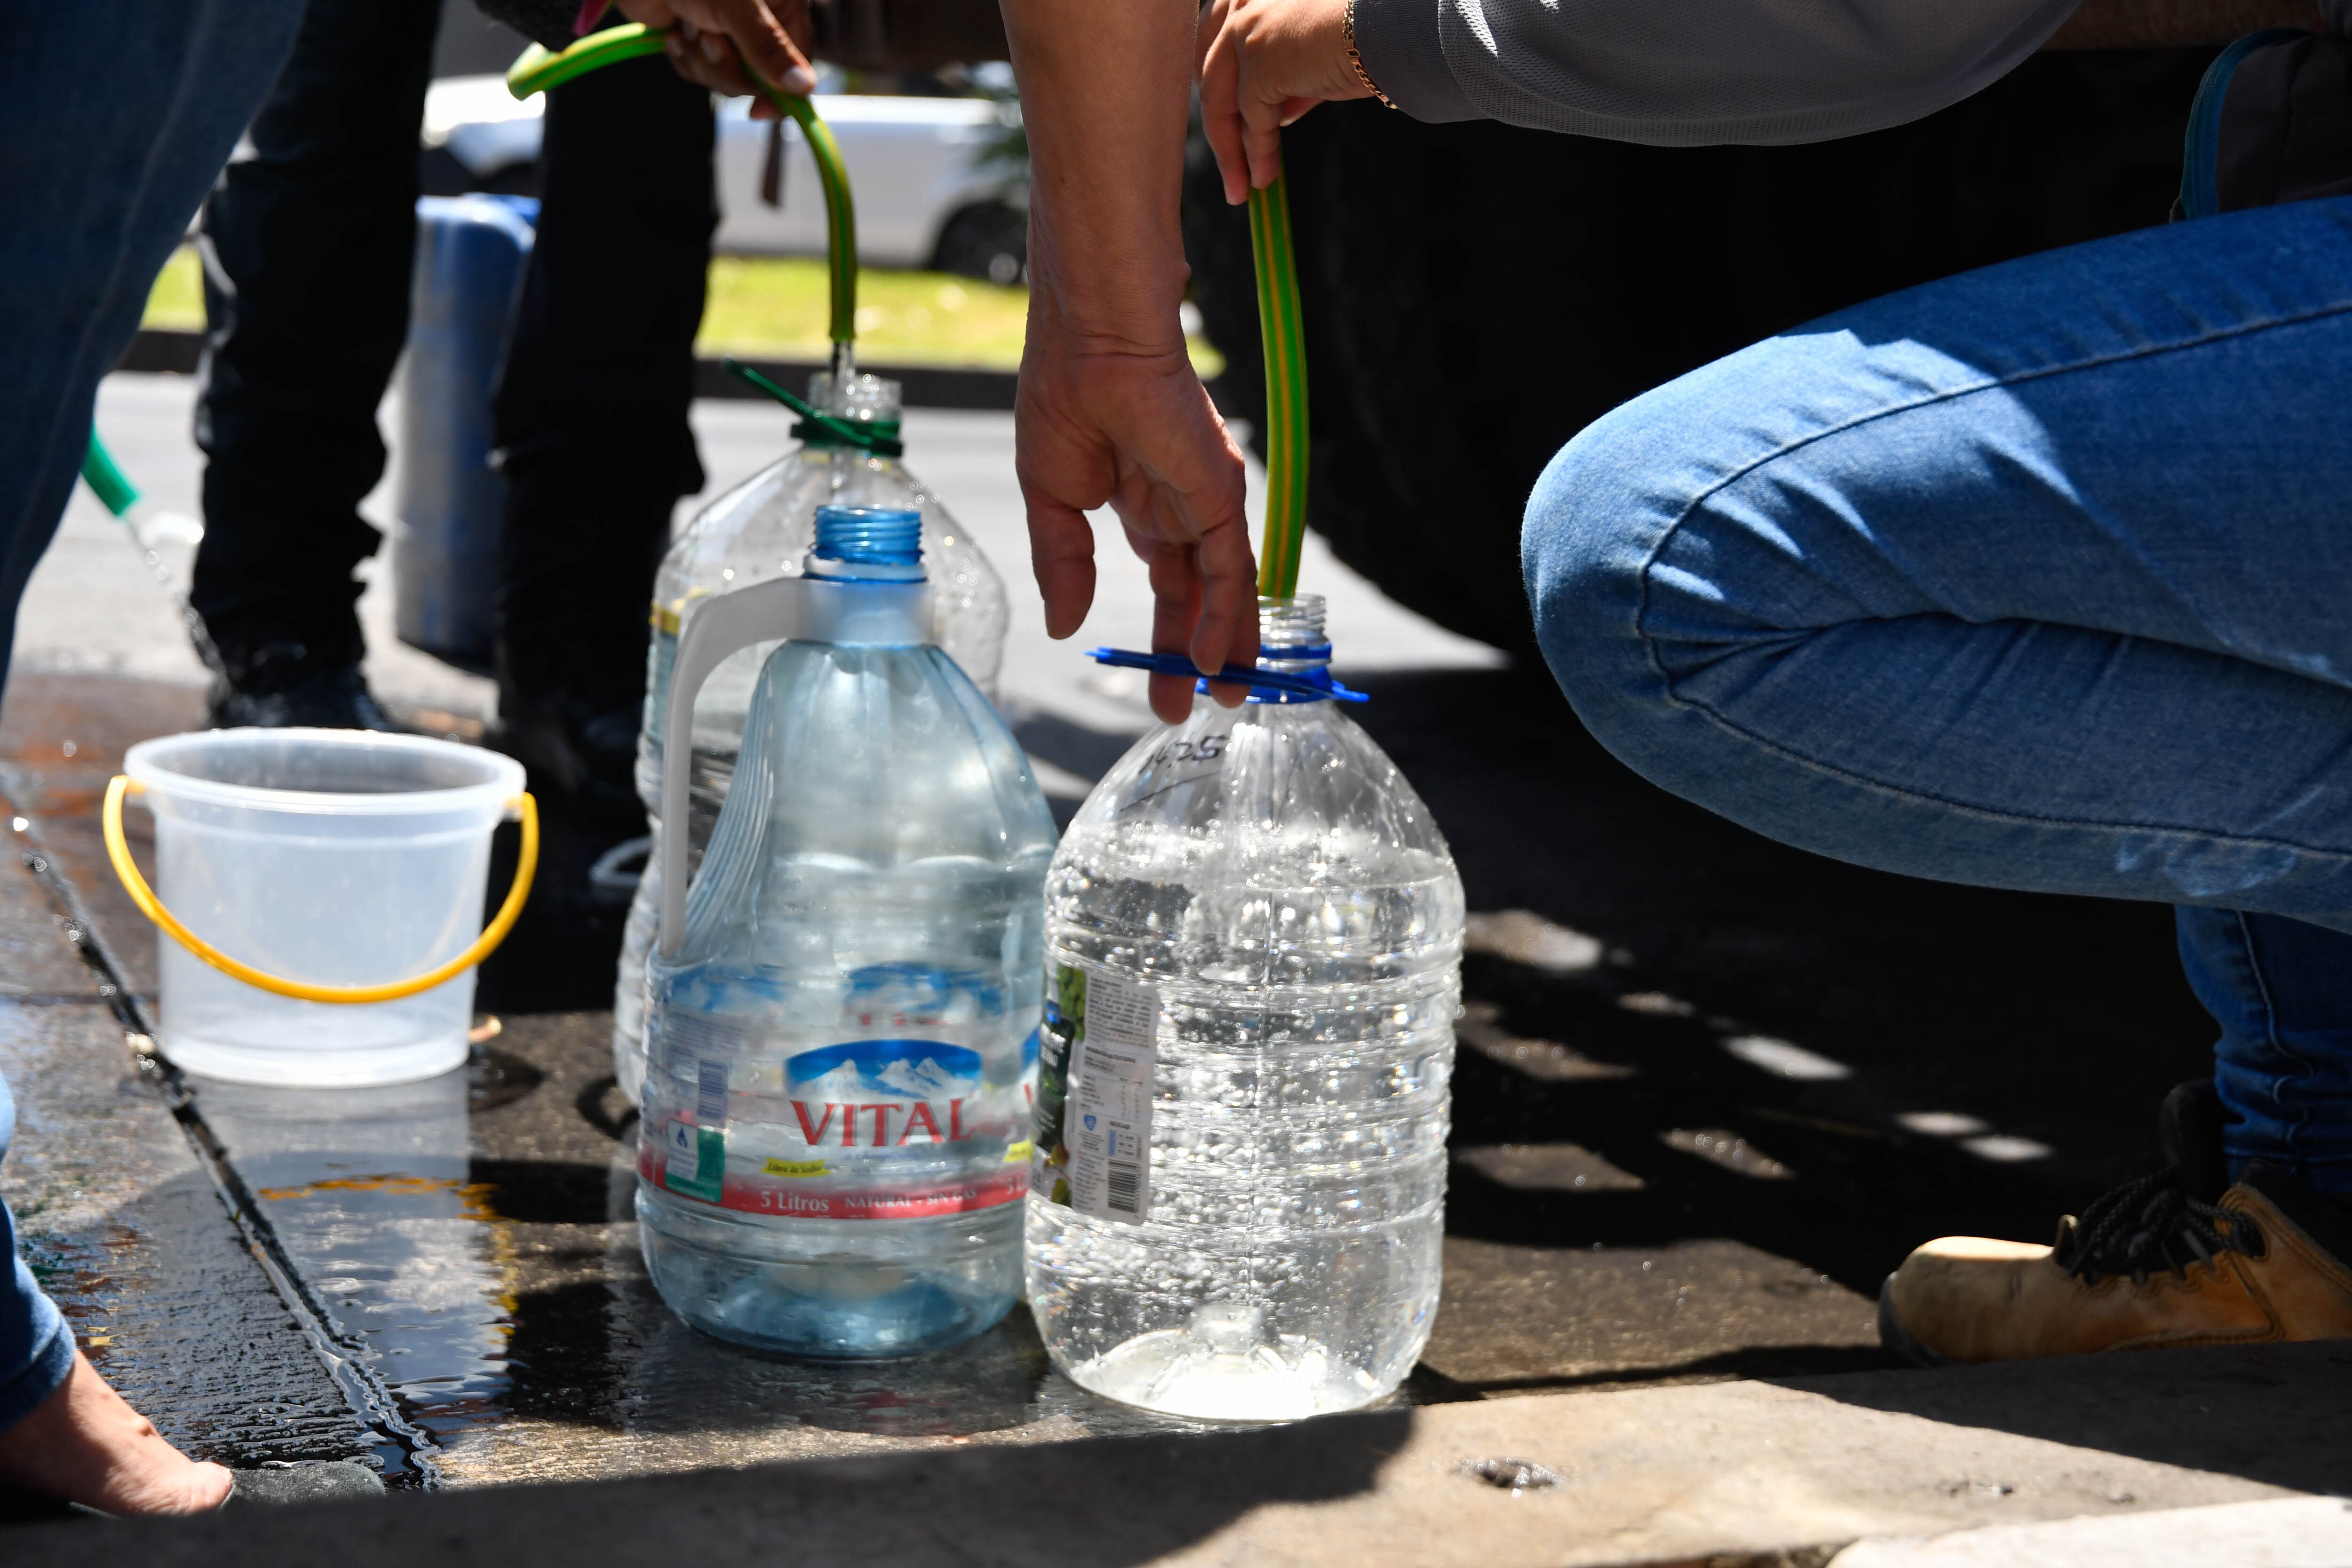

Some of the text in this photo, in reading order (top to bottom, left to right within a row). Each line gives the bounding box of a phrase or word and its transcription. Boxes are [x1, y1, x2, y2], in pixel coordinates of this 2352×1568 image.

[790, 1097, 974, 1146] VITAL
[801, 1164, 822, 1173] Sodio
[761, 1191, 829, 1211] 5 Litros
[845, 1194, 913, 1208] NATURAL
[926, 1193, 949, 1205] SIN
[953, 1188, 977, 1201] GAS
